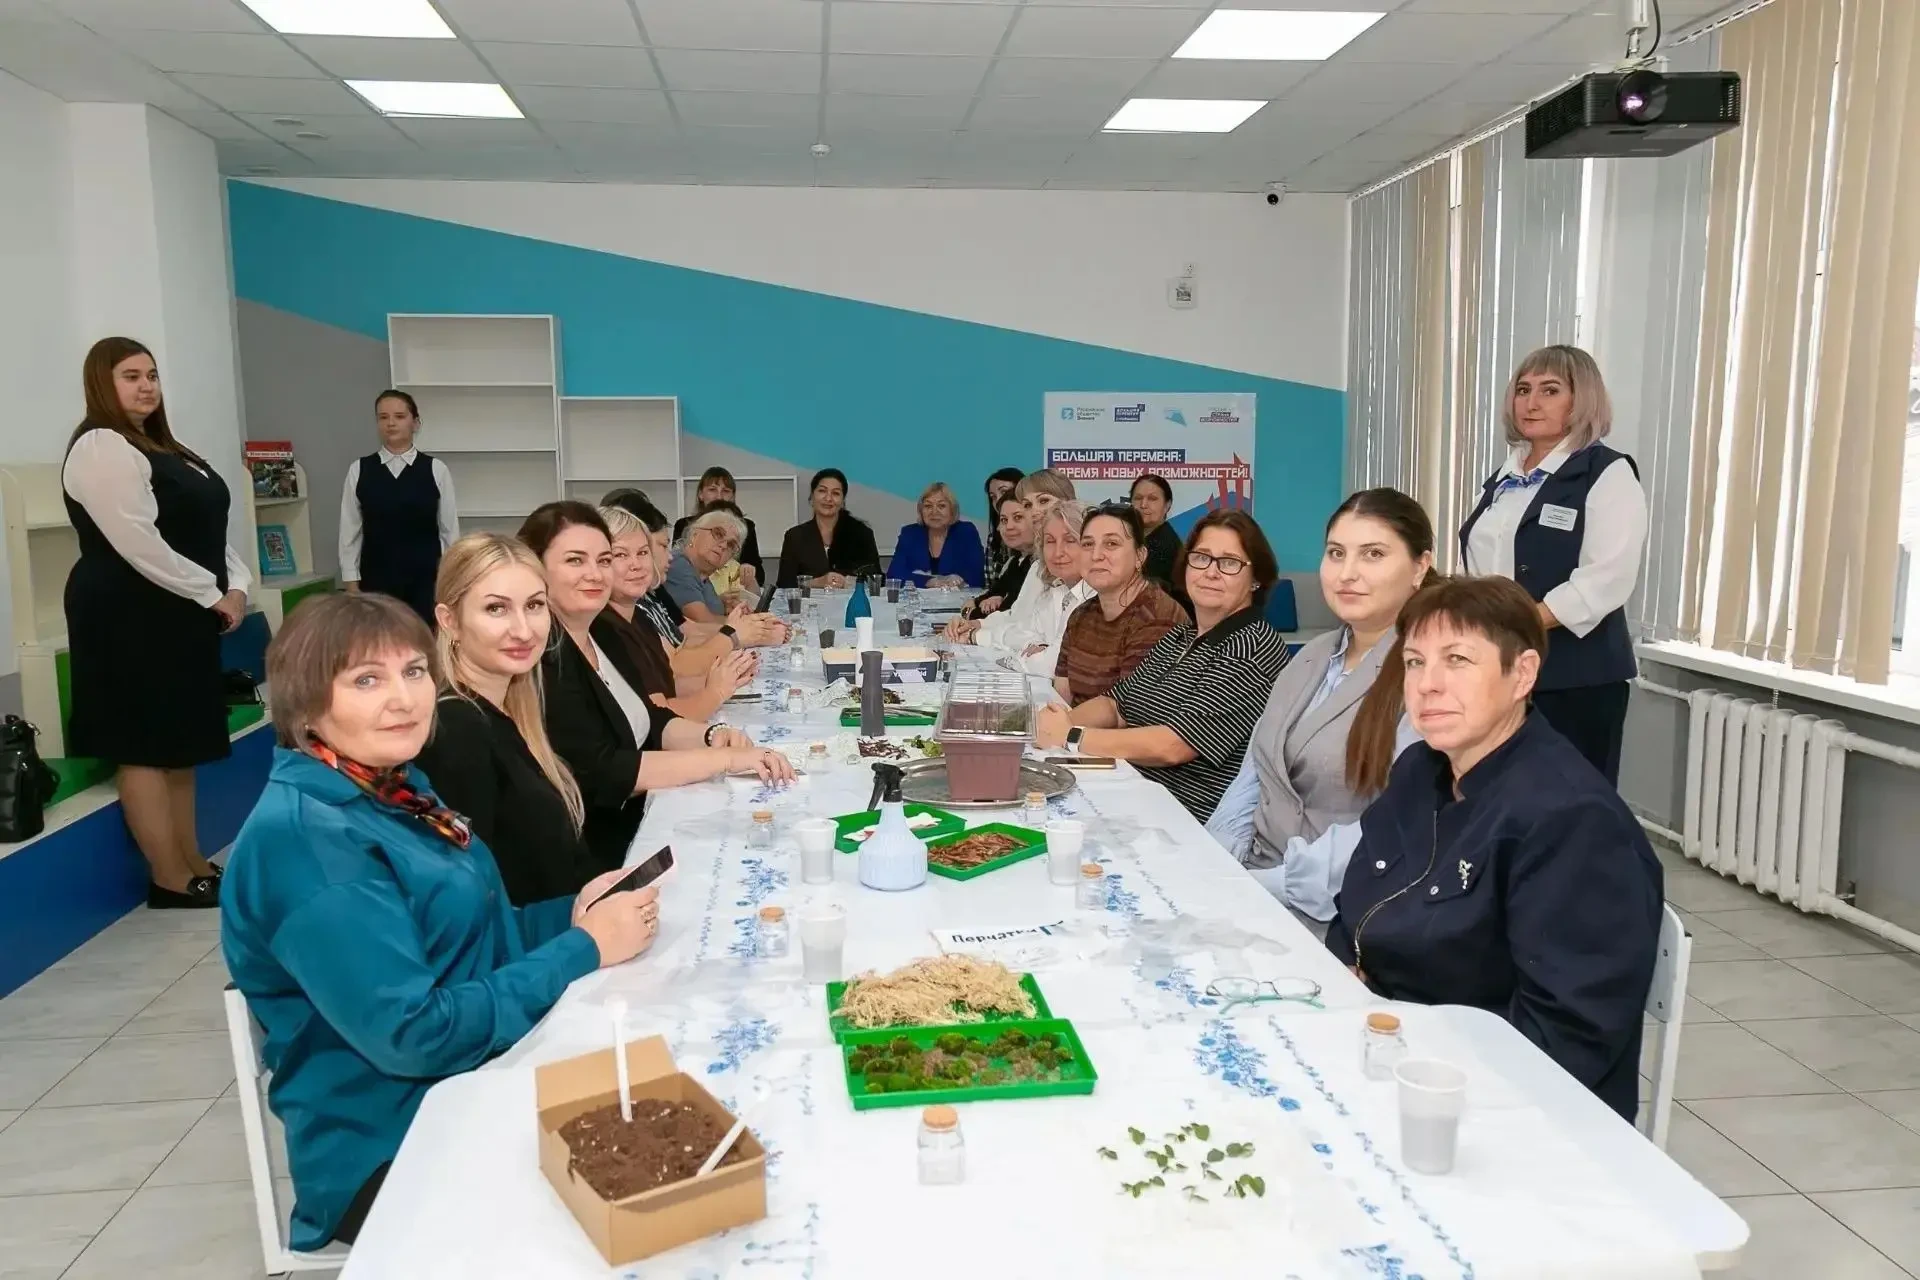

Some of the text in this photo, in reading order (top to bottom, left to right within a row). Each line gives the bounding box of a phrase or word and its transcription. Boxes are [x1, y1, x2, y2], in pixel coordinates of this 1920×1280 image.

[1053, 451, 1180, 462] БОЛЬШАЯ ПЕРЕМЕНА:
[1103, 467, 1144, 478] НОВЫХ
[1148, 465, 1248, 478] ВОЗМОЖНОСТЕЙ!
